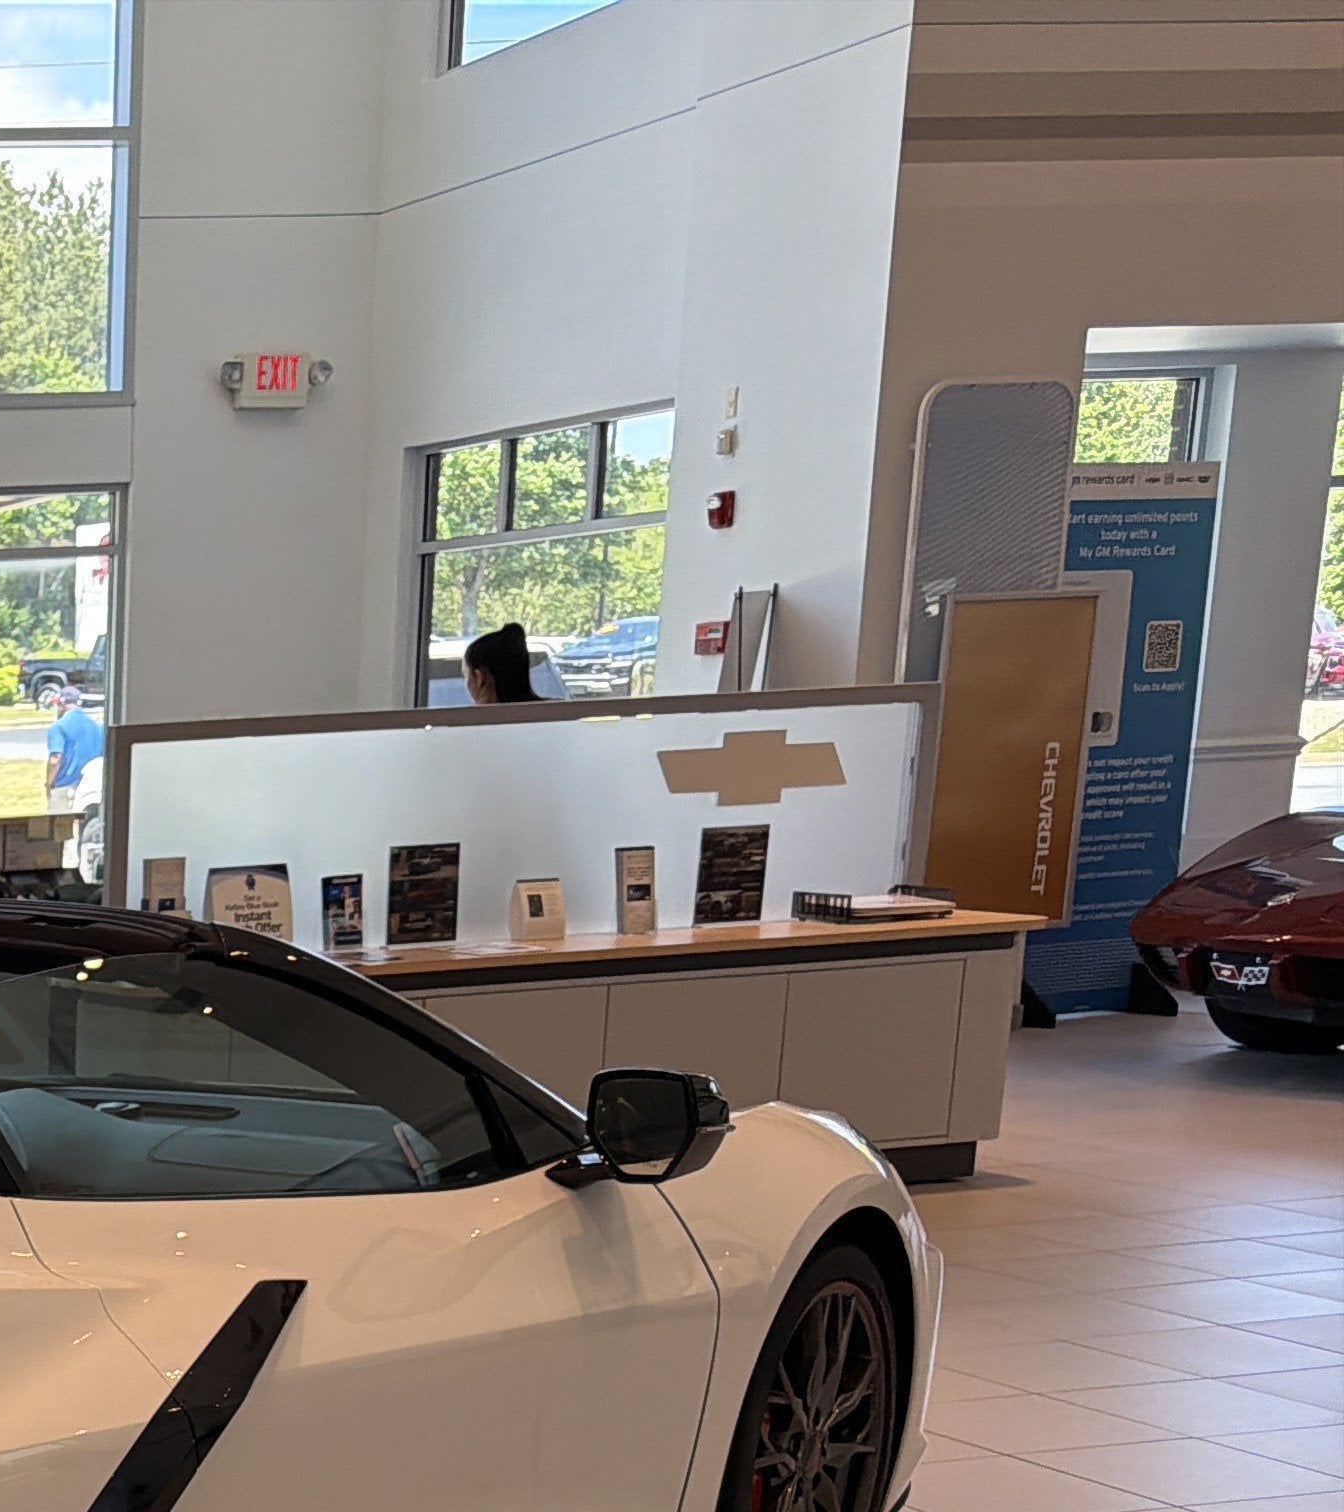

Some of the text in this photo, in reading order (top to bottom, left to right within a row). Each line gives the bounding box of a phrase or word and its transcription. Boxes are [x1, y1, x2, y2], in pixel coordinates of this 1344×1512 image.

[257, 355, 302, 391] EXIT
[1082, 475, 1114, 485] rewards
[1116, 474, 1135, 485] card
[1088, 512, 1122, 525] earning
[1125, 511, 1169, 523] unlimited
[1170, 510, 1199, 525] points
[1100, 529, 1157, 543] today with a
[1079, 547, 1093, 559] My
[1114, 545, 1151, 557] Rewards
[1153, 545, 1176, 557] Card
[1031, 742, 1060, 895] CHEVROLET
[234, 910, 272, 922] Instant
[255, 922, 283, 933] Offer
